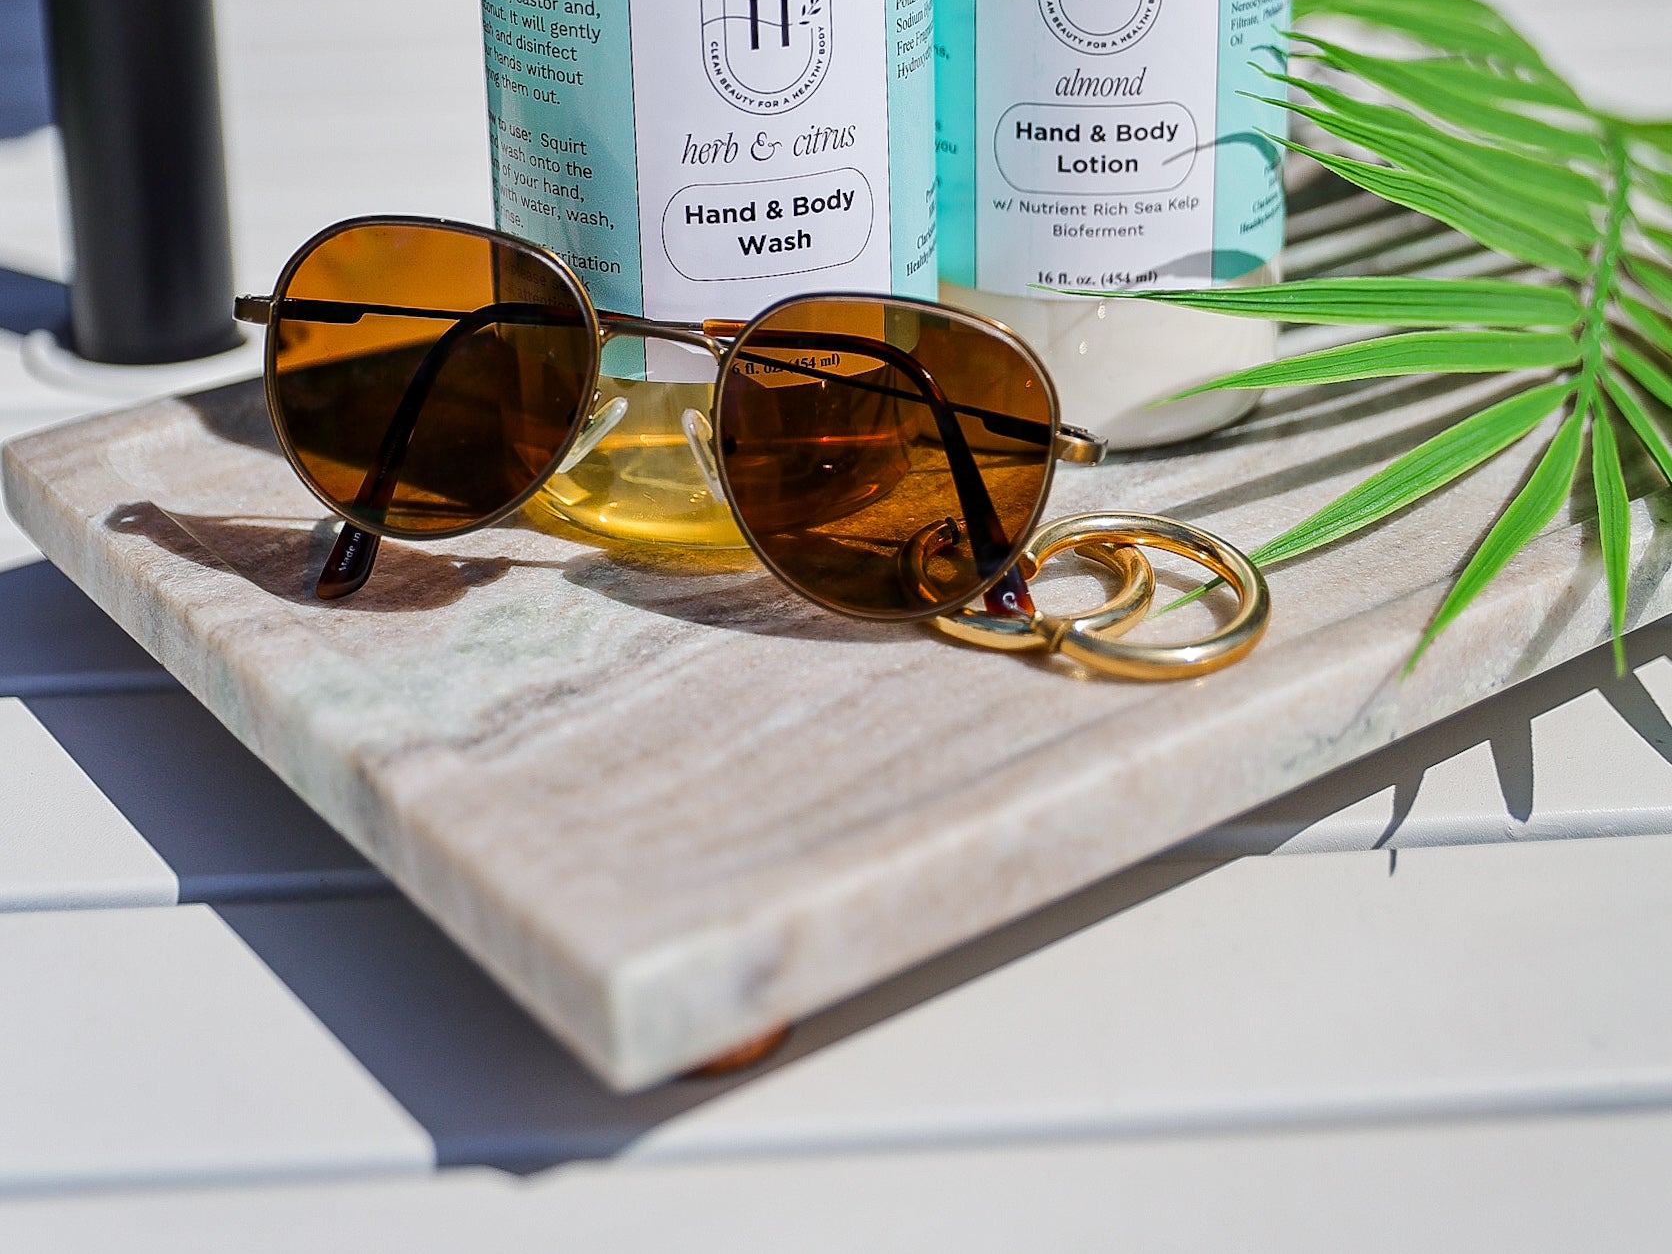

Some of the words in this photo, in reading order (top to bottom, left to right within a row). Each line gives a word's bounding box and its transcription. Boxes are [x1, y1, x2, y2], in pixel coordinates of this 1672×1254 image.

[564, 1, 601, 19] and,
[896, 11, 923, 33] Sodium
[510, 11, 519, 25] It
[522, 17, 546, 33] will
[551, 22, 601, 44] gently
[1052, 16, 1084, 45] BEAUTY
[1120, 8, 1152, 44] HEALTHY
[496, 28, 513, 46] and
[516, 34, 578, 61] disinfect
[897, 38, 914, 57] Free
[494, 46, 522, 72] hands
[526, 64, 584, 86] without
[711, 41, 722, 76] CLEAN
[720, 78, 755, 106] BEAUTY
[758, 100, 779, 108] FOR
[783, 97, 790, 105] A
[792, 59, 824, 100] HEALTHY
[1055, 66, 1147, 97] almond
[502, 74, 529, 97] them
[533, 89, 561, 105] out.
[498, 115, 506, 132] to
[509, 125, 533, 143] use:
[540, 133, 588, 156] Squirt
[681, 132, 739, 165] herb
[750, 131, 782, 161] &
[793, 124, 856, 157] citrus
[1016, 121, 1080, 142] Hand
[1090, 125, 1106, 142] &
[1117, 121, 1179, 142] Body
[501, 141, 526, 163] wash
[529, 154, 561, 173] onto
[565, 161, 593, 179] the
[1057, 155, 1138, 173] Lotion
[502, 163, 511, 177] of
[513, 168, 539, 190] your
[544, 178, 585, 203] hand,
[500, 184, 518, 204] with
[521, 195, 561, 221] water,
[566, 208, 615, 231] wash,
[685, 201, 756, 224] Hand
[766, 200, 784, 220] &
[793, 188, 855, 217] Body
[993, 199, 1012, 211] w/
[1019, 201, 1087, 216] Nutrient
[1093, 202, 1127, 215] Rich
[1134, 202, 1162, 214] Sea
[1168, 196, 1199, 211] Kelp
[738, 229, 812, 256] Wash
[1053, 224, 1144, 238] Bioferment
[1038, 271, 1053, 284] 16
[1058, 271, 1072, 285] fl.
[1077, 275, 1096, 286] oz.
[1101, 271, 1131, 286] (454
[1135, 271, 1158, 285] ml)
[820, 353, 840, 368] ml)
